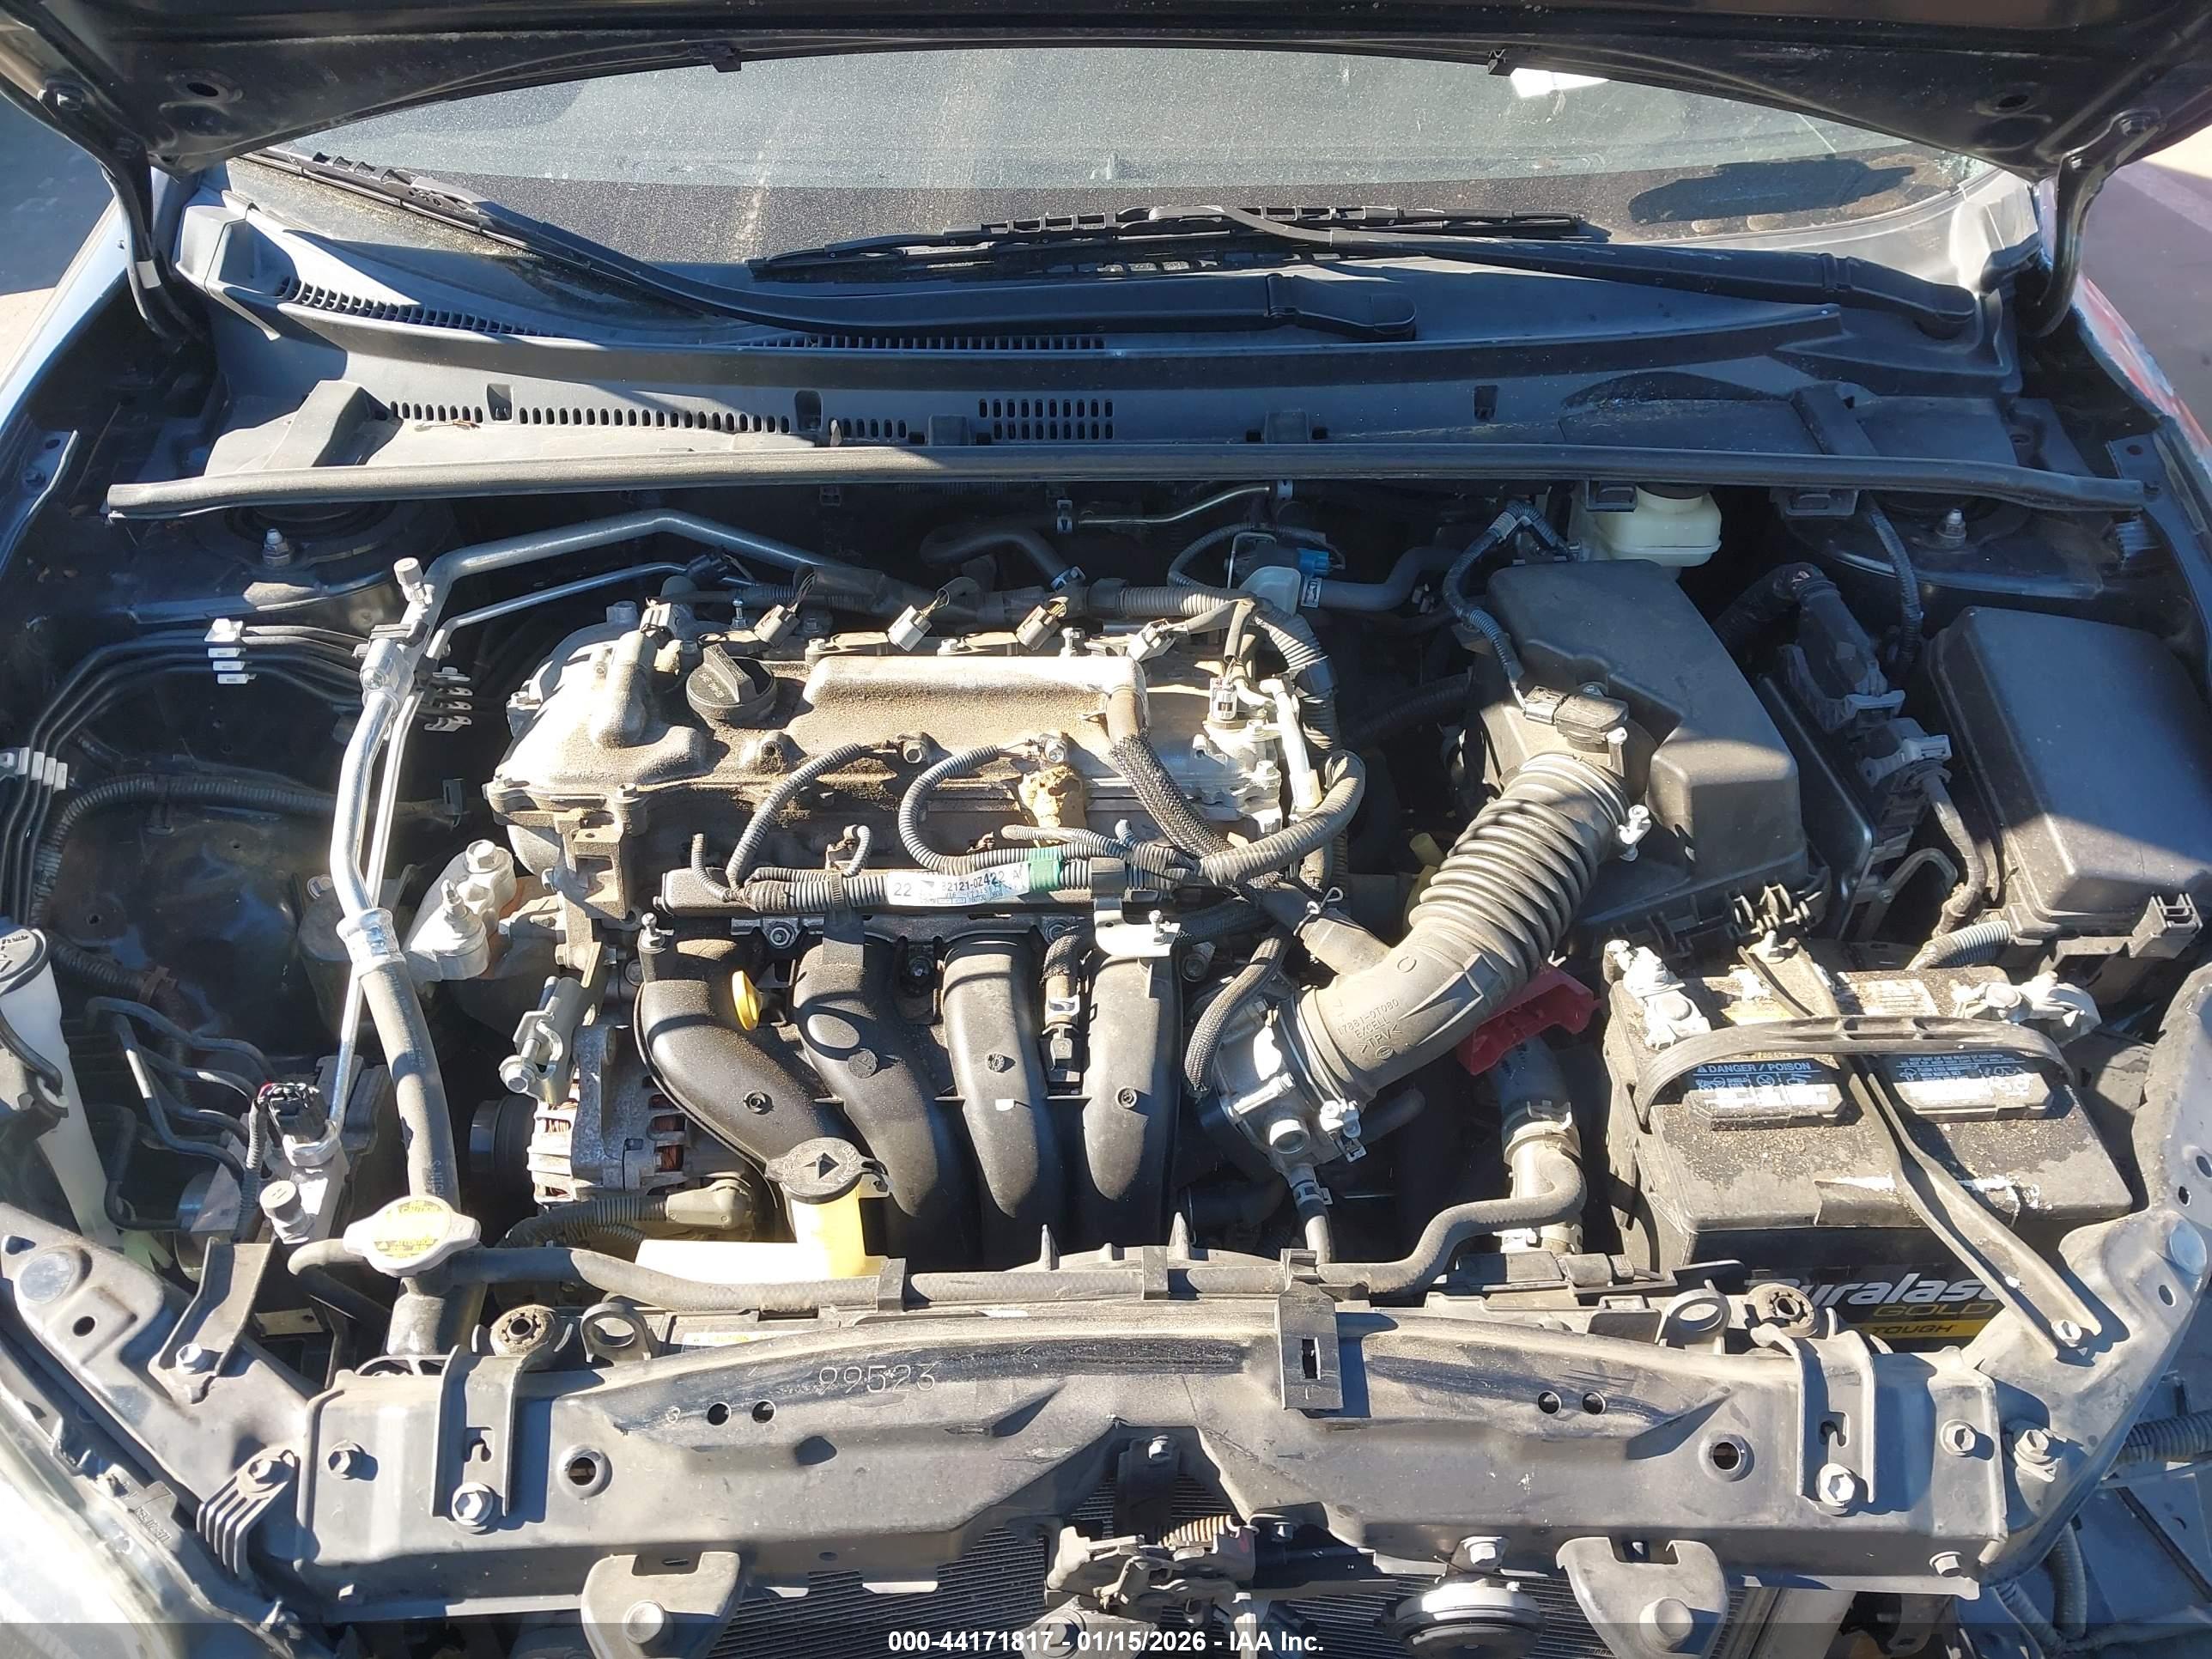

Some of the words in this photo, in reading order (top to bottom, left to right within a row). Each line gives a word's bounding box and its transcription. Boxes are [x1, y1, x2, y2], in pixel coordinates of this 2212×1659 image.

[892, 882, 913, 897] 22
[1354, 1016, 1391, 1039] EXCELL
[1707, 1064, 1757, 1073] DANGER
[1767, 1062, 1812, 1072] POISON
[1744, 1273, 1997, 1306] uralas
[1873, 1303, 1995, 1317] GOLD
[1871, 1324, 1954, 1334] TOUGH
[818, 1363, 939, 1395] 99523
